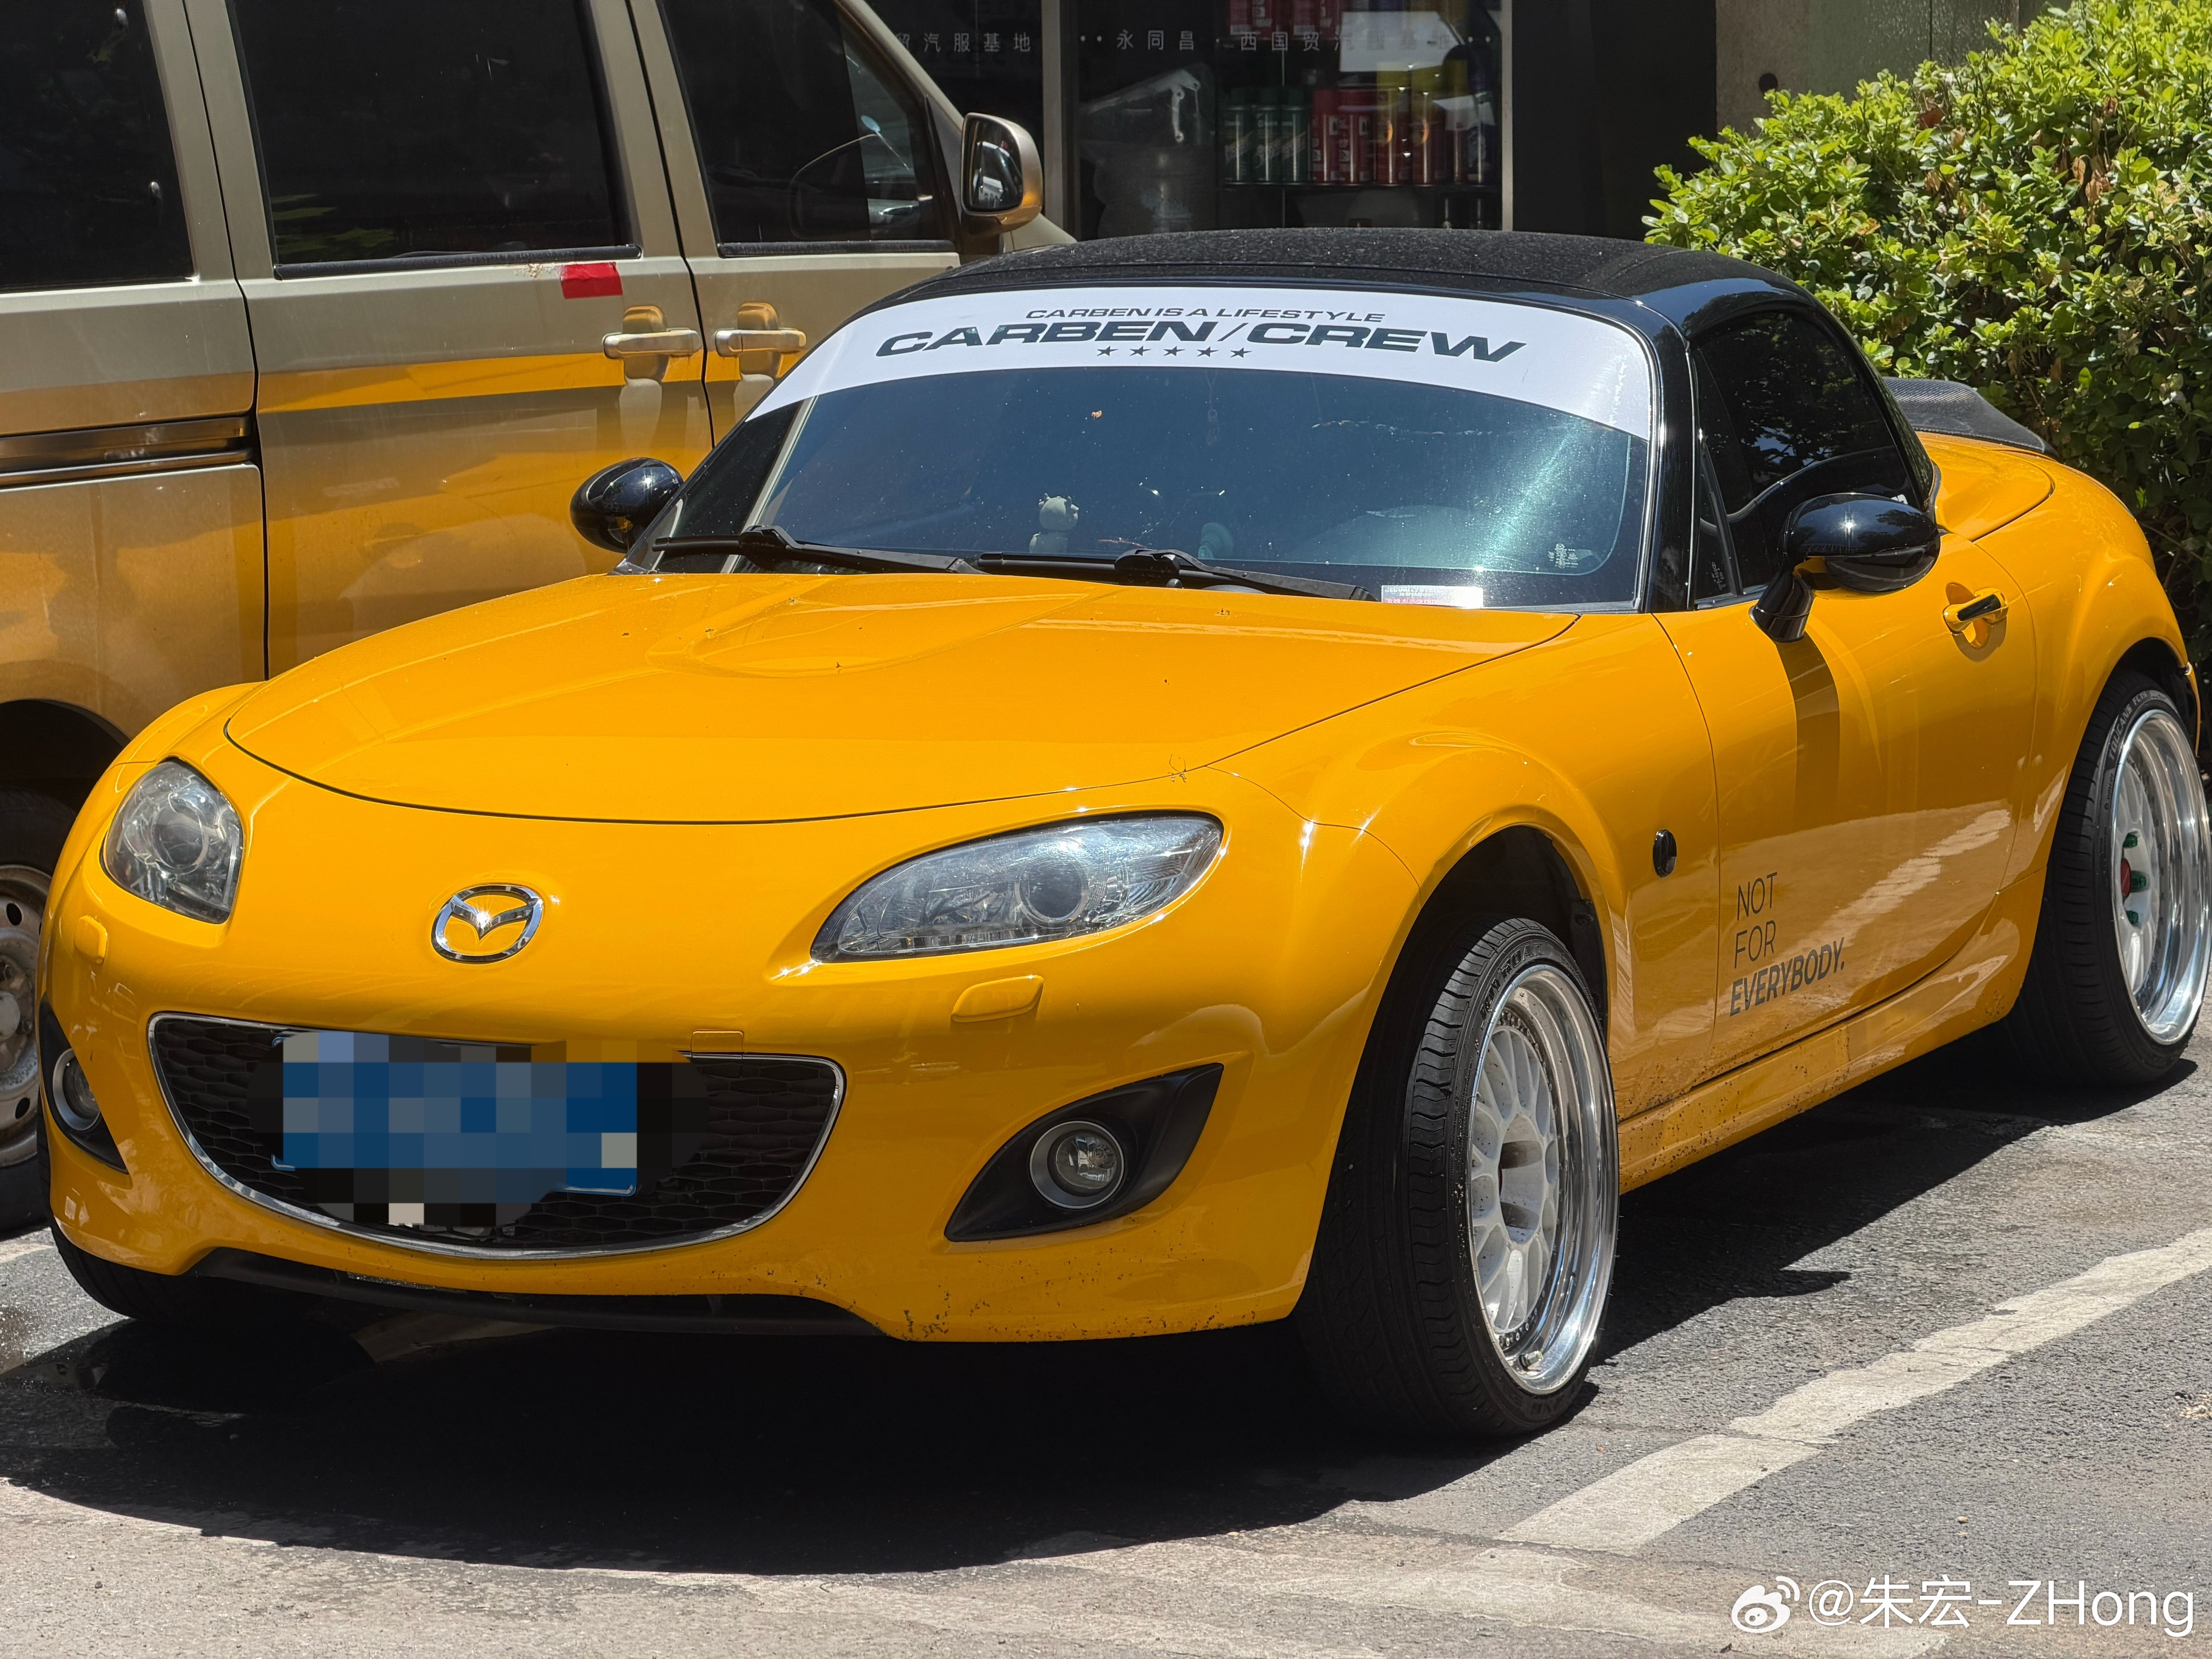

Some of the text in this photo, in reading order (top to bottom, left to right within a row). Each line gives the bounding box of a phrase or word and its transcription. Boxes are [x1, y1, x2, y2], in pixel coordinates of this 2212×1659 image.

[1026, 308, 1386, 323] CARBEN IS A LIFESTYLE
[875, 321, 1527, 362] CARBEN/CREW
[2108, 704, 2133, 761] TOUCANS
[1737, 871, 1778, 921] NOT
[1734, 920, 1776, 969] FOR
[1730, 936, 1845, 1017] EVERYBODY.
